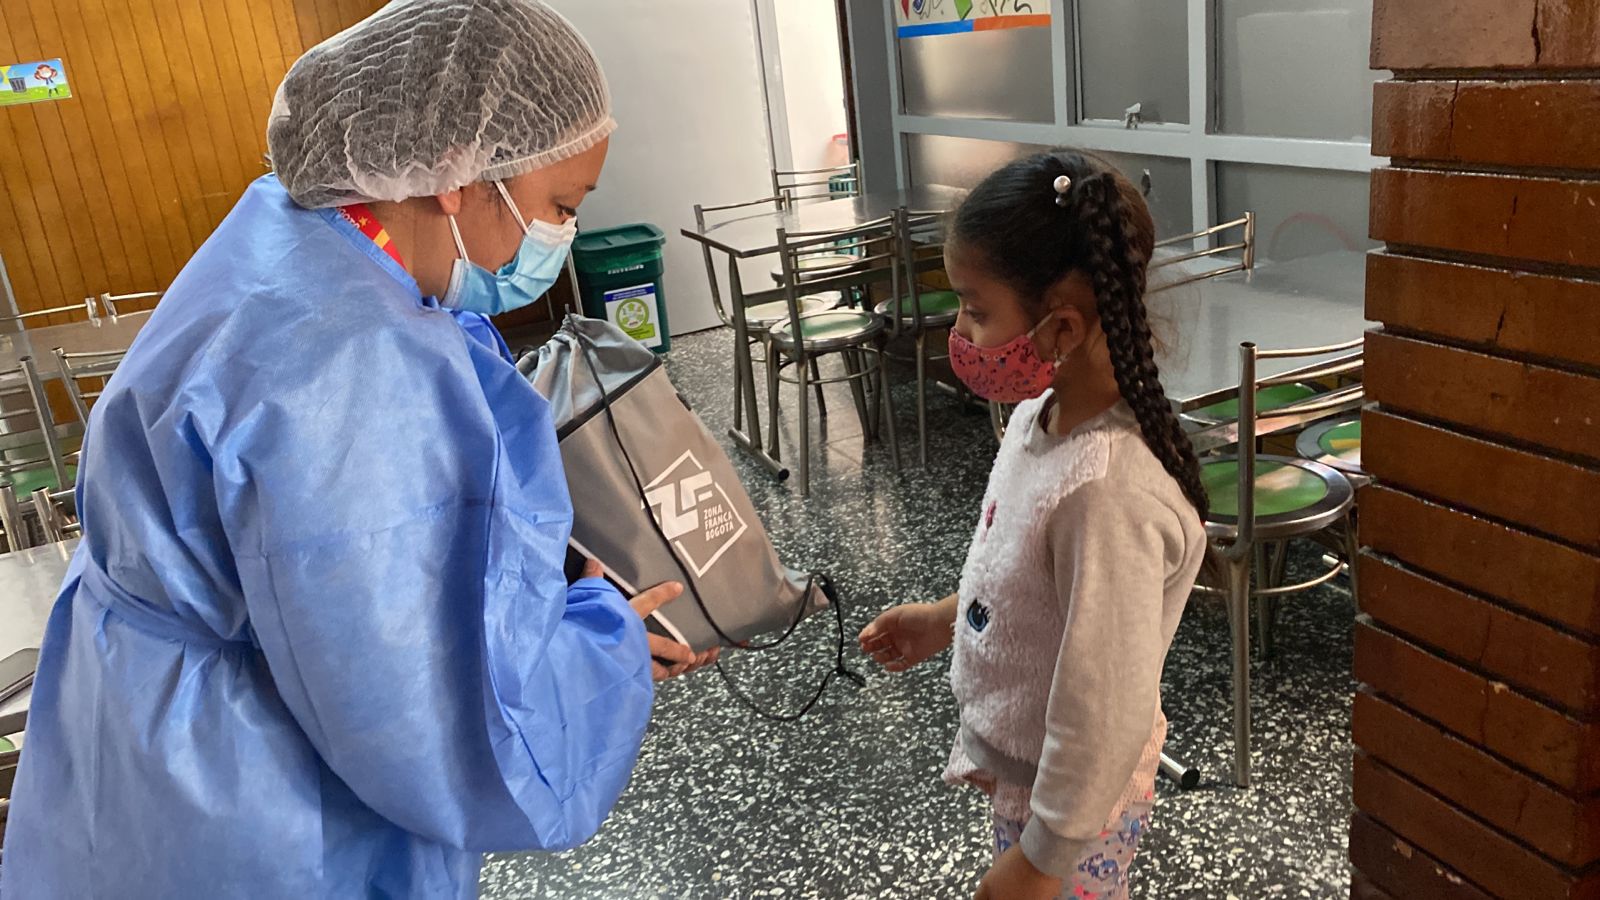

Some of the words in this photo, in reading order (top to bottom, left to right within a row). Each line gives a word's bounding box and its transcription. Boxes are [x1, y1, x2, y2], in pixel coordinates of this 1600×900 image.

[703, 504, 723, 520] ZONA
[704, 511, 733, 531] FRANCA
[705, 521, 734, 541] BOGOTA
